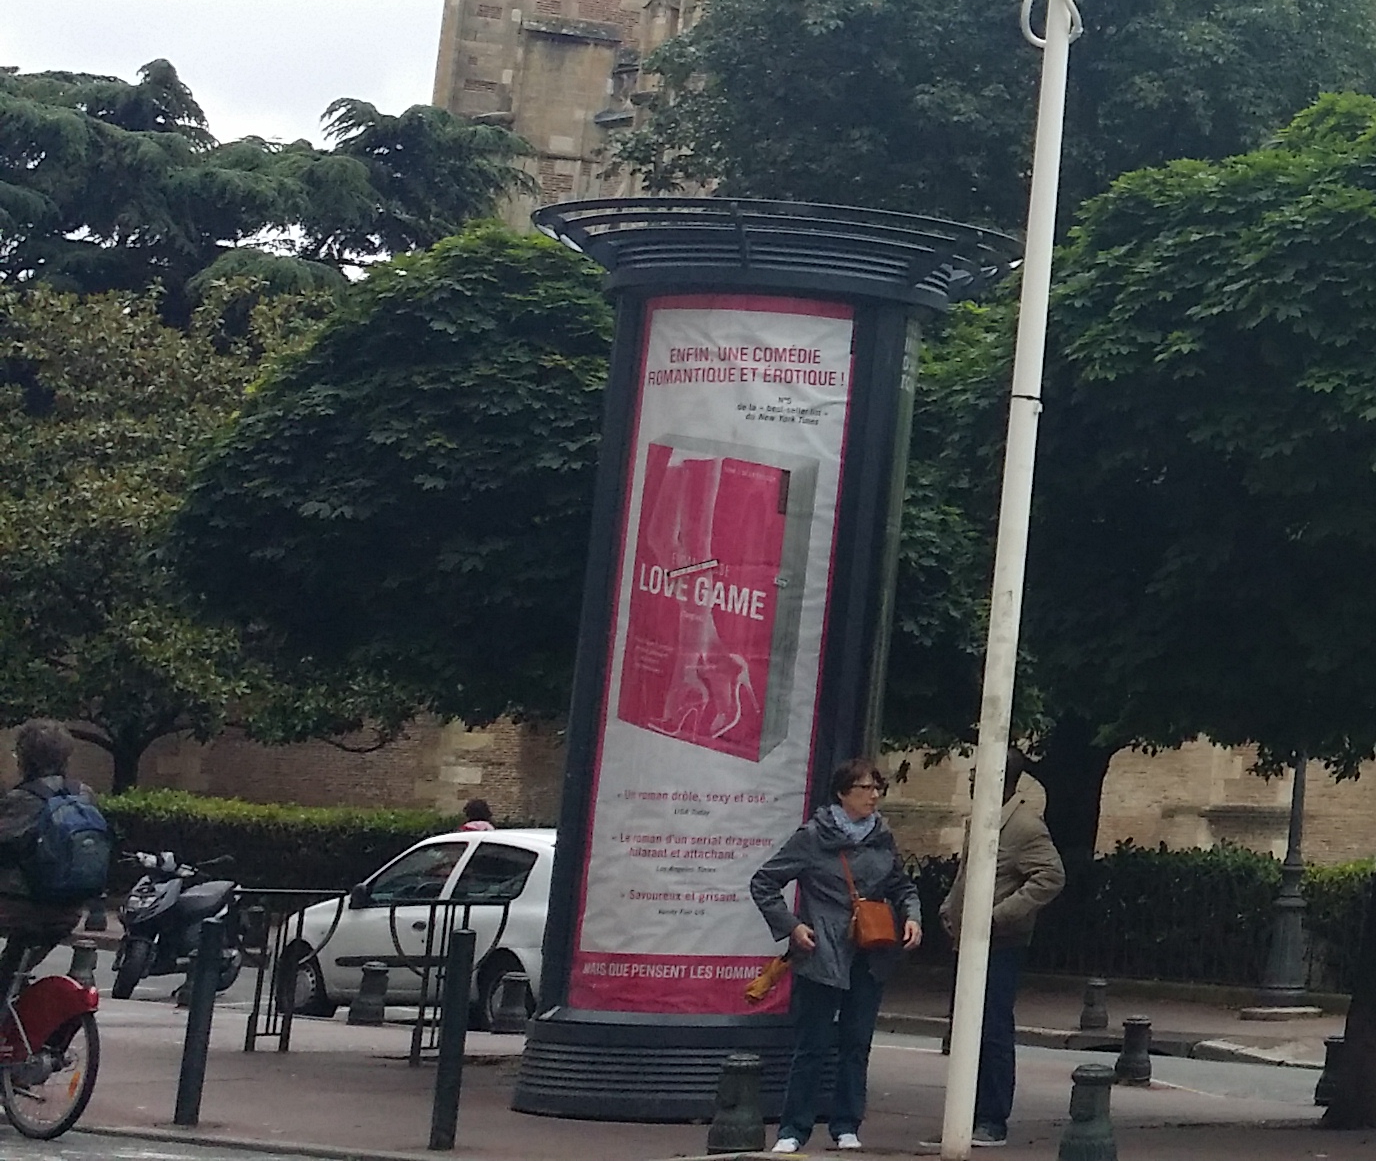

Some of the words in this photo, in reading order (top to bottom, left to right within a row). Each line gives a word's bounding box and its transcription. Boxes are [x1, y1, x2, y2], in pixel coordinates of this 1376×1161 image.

[670, 347, 714, 364] ENFIN,
[718, 347, 749, 362] UNE
[752, 344, 821, 365] COMÉDIE
[648, 367, 736, 386] ROMANTIQUE
[740, 367, 759, 382] ET
[763, 364, 837, 386] ÉROTIQUE
[639, 563, 688, 601] LOVE
[694, 576, 767, 621] GAME
[638, 791, 668, 800] roman
[706, 793, 731, 804] sexy
[734, 793, 744, 803] et
[691, 835, 722, 845] serial
[670, 848, 681, 858] et
[629, 890, 681, 901] Savoureux
[684, 890, 695, 900] et
[582, 962, 607, 976] MAIS
[608, 963, 631, 977] QUE
[631, 963, 688, 979] PENSENT
[689, 965, 713, 979] LES
[715, 966, 763, 980] HOMME
